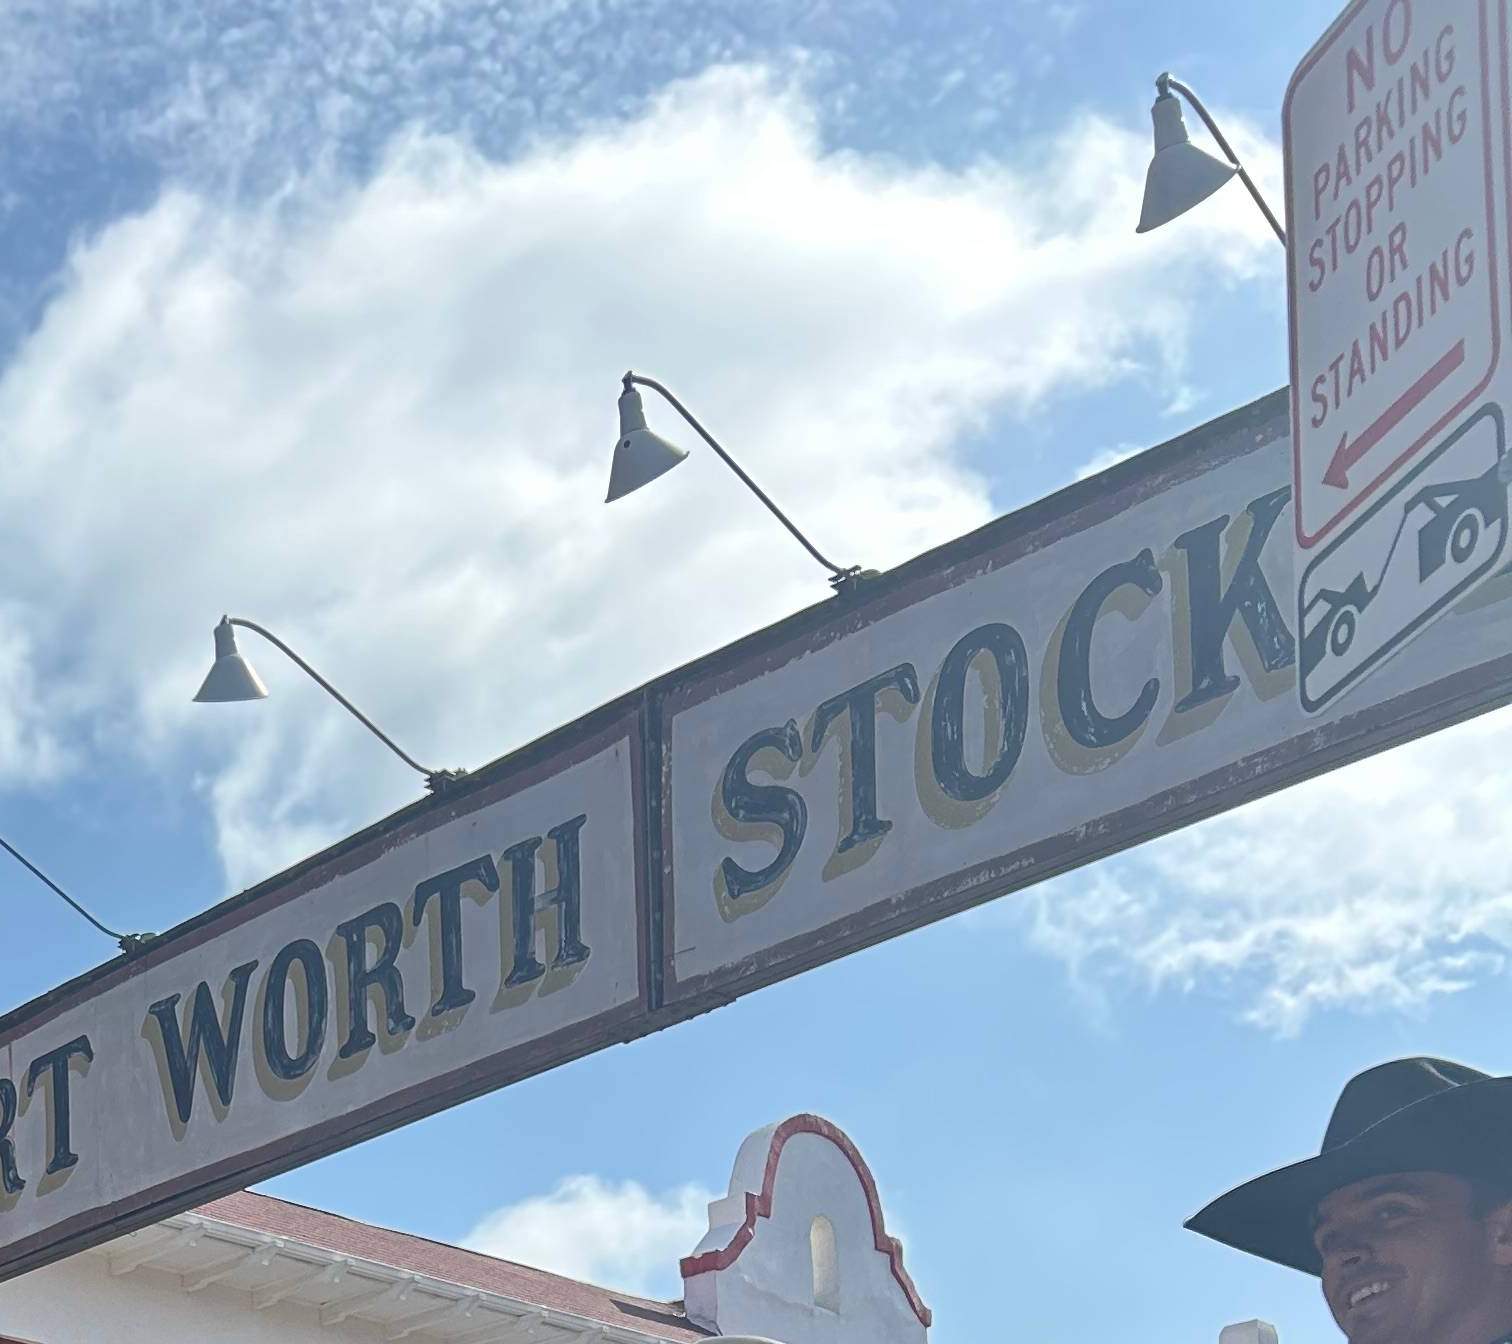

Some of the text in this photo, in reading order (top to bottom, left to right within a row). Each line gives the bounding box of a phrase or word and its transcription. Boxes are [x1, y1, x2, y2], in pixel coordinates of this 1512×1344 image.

[1313, 24, 1455, 220] PARKING
[1346, 0, 1411, 114] NO
[1308, 84, 1468, 293] STOPPING
[1365, 220, 1410, 304] OR
[1310, 227, 1476, 430] STANDING
[146, 814, 591, 1128] WORTH
